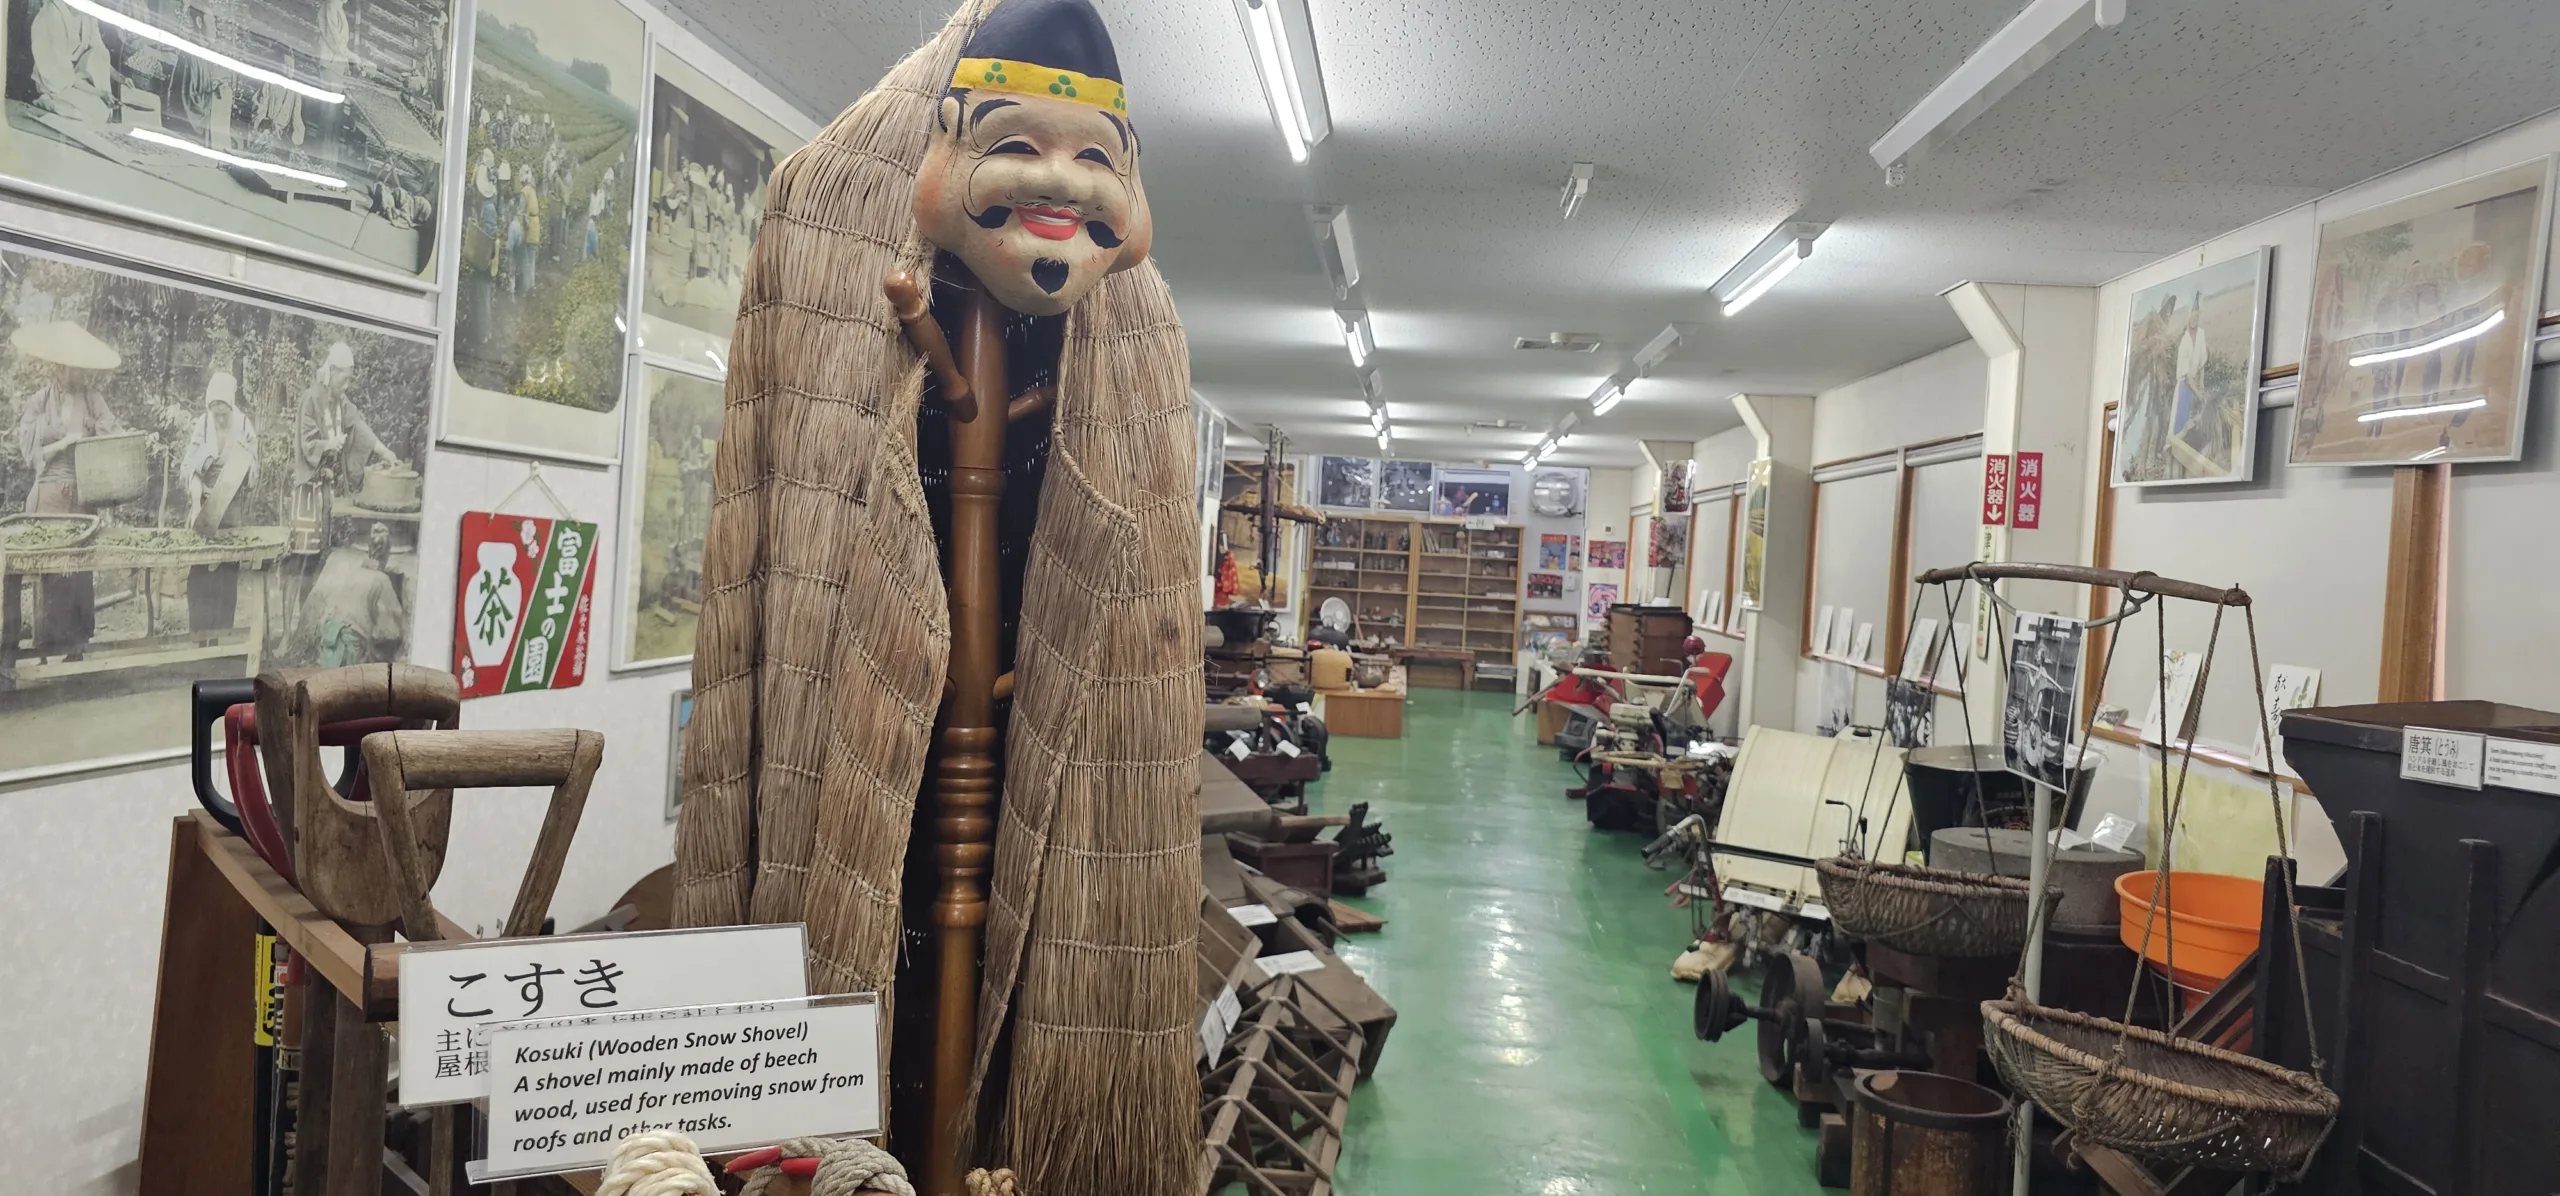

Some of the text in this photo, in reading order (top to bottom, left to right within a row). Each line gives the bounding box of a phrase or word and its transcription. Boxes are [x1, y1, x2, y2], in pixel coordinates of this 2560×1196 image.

[1987, 458, 2006, 505] 消火器
[2017, 458, 2038, 522] 消火器
[473, 566, 514, 647] 茶
[520, 526, 583, 685] 富士の園
[446, 959, 624, 1018] こすき
[514, 1021, 808, 1064] Kosuki (Wooden Snow Shovel)
[514, 1048, 818, 1093] A shovel mainly made of beech
[515, 1073, 863, 1122] wood, used for removing snow from
[513, 1129, 566, 1153] roofs
[573, 1125, 613, 1146] and
[678, 1113, 732, 1133] tasks.
